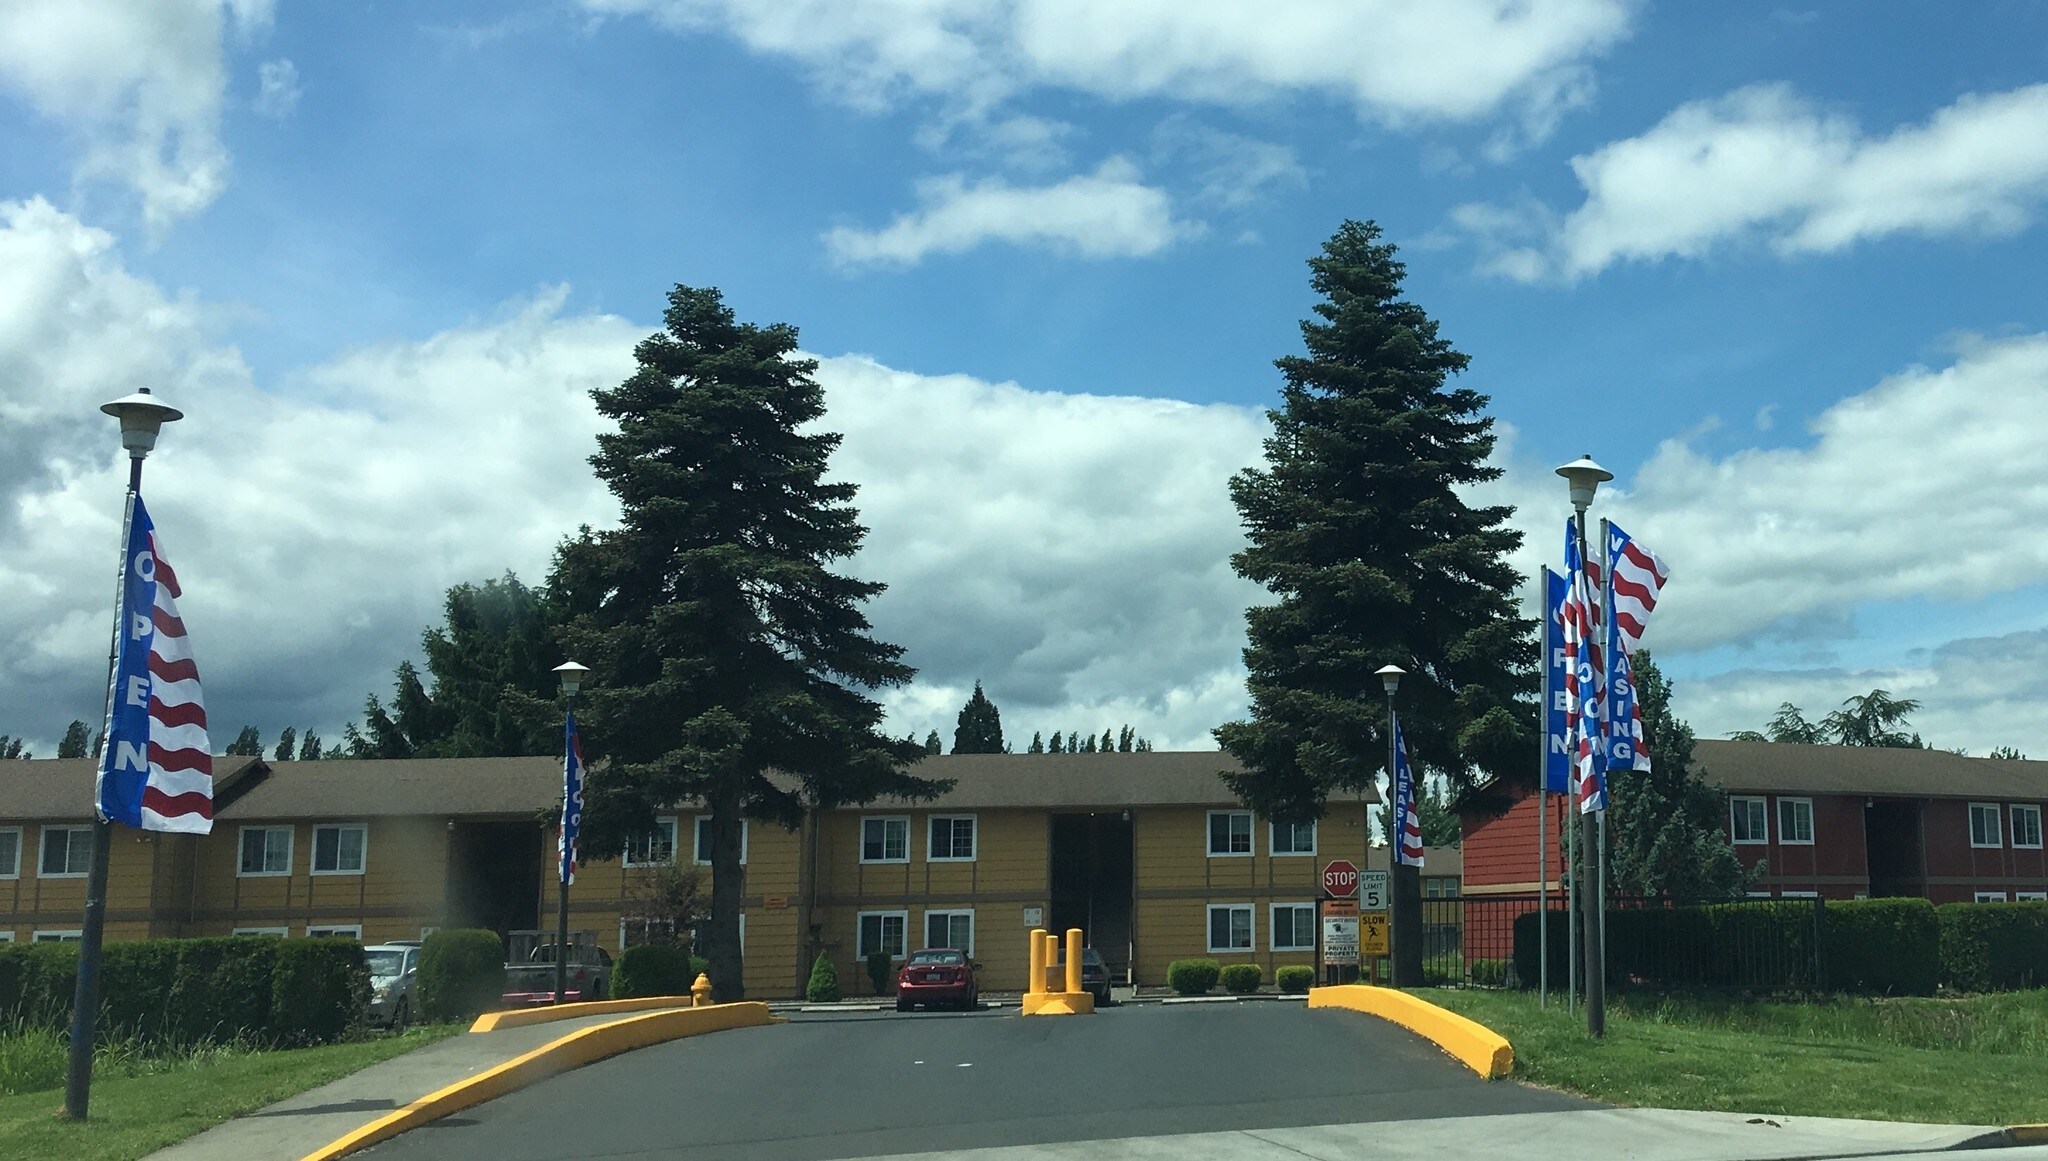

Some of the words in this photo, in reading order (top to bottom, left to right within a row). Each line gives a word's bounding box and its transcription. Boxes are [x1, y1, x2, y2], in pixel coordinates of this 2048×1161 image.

[114, 551, 156, 772] OPEN
[1325, 871, 1356, 886] STOP
[1367, 892, 1379, 907] 5
[1362, 916, 1385, 925] SLOW
